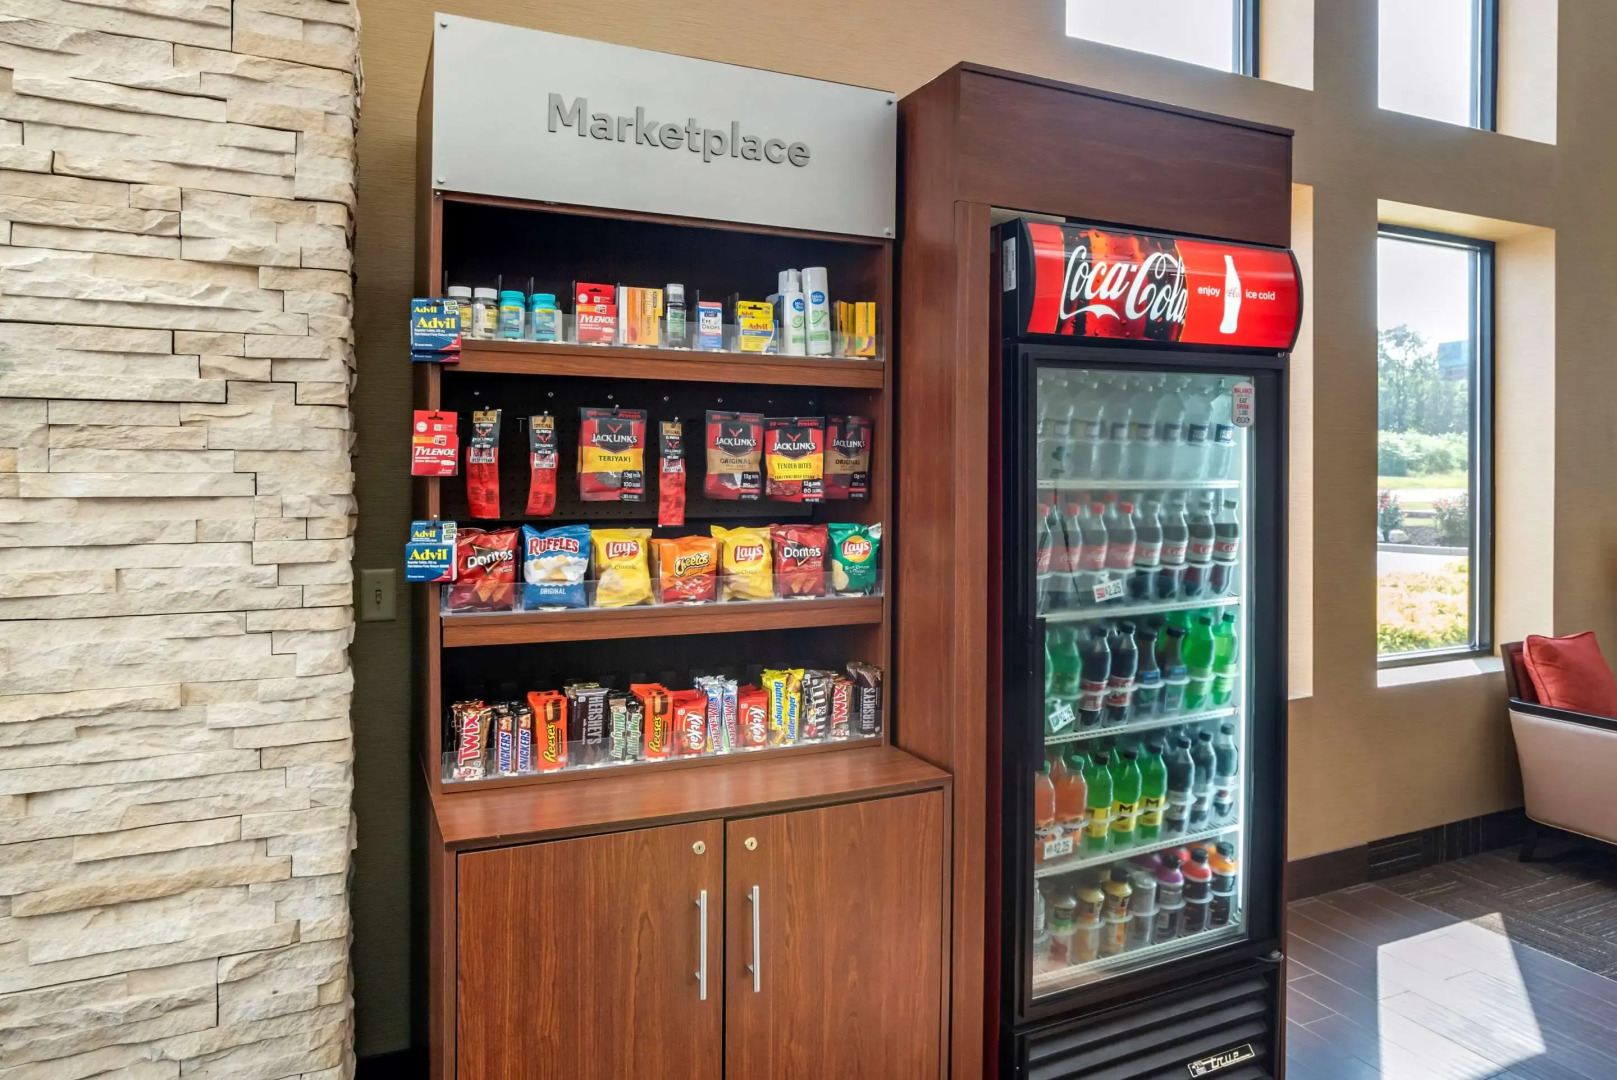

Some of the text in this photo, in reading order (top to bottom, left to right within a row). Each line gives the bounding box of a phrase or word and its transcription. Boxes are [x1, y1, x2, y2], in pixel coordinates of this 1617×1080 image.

[547, 92, 811, 167] Marketplace
[1060, 246, 1187, 323] Coca-Cola
[1197, 285, 1221, 297] enjoy
[1245, 290, 1258, 299] ice
[1259, 291, 1276, 300] cold
[416, 317, 456, 329] Advil
[580, 315, 615, 325] TYLENOL
[591, 434, 613, 443] JACK
[715, 437, 734, 446] JACK
[772, 442, 793, 451] JACK
[414, 446, 456, 456] TYLENOL
[409, 548, 448, 560] Advil
[528, 537, 580, 556] RUFFLES
[784, 546, 822, 558] Doritos
[467, 549, 514, 569] Doritos
[675, 552, 710, 577] Cheetos
[540, 587, 567, 595] ORIGINAL
[774, 680, 784, 727] Butterfinger
[831, 684, 847, 728] TWIX
[862, 687, 875, 730] HERSHEY'S
[587, 695, 604, 745] HERSHEY'S
[786, 695, 798, 739] Butterfinger
[458, 713, 481, 766] TWIX
[519, 729, 531, 770] SNICKERS
[500, 732, 512, 772] SNICKERS
[1210, 1050, 1239, 1070] true
